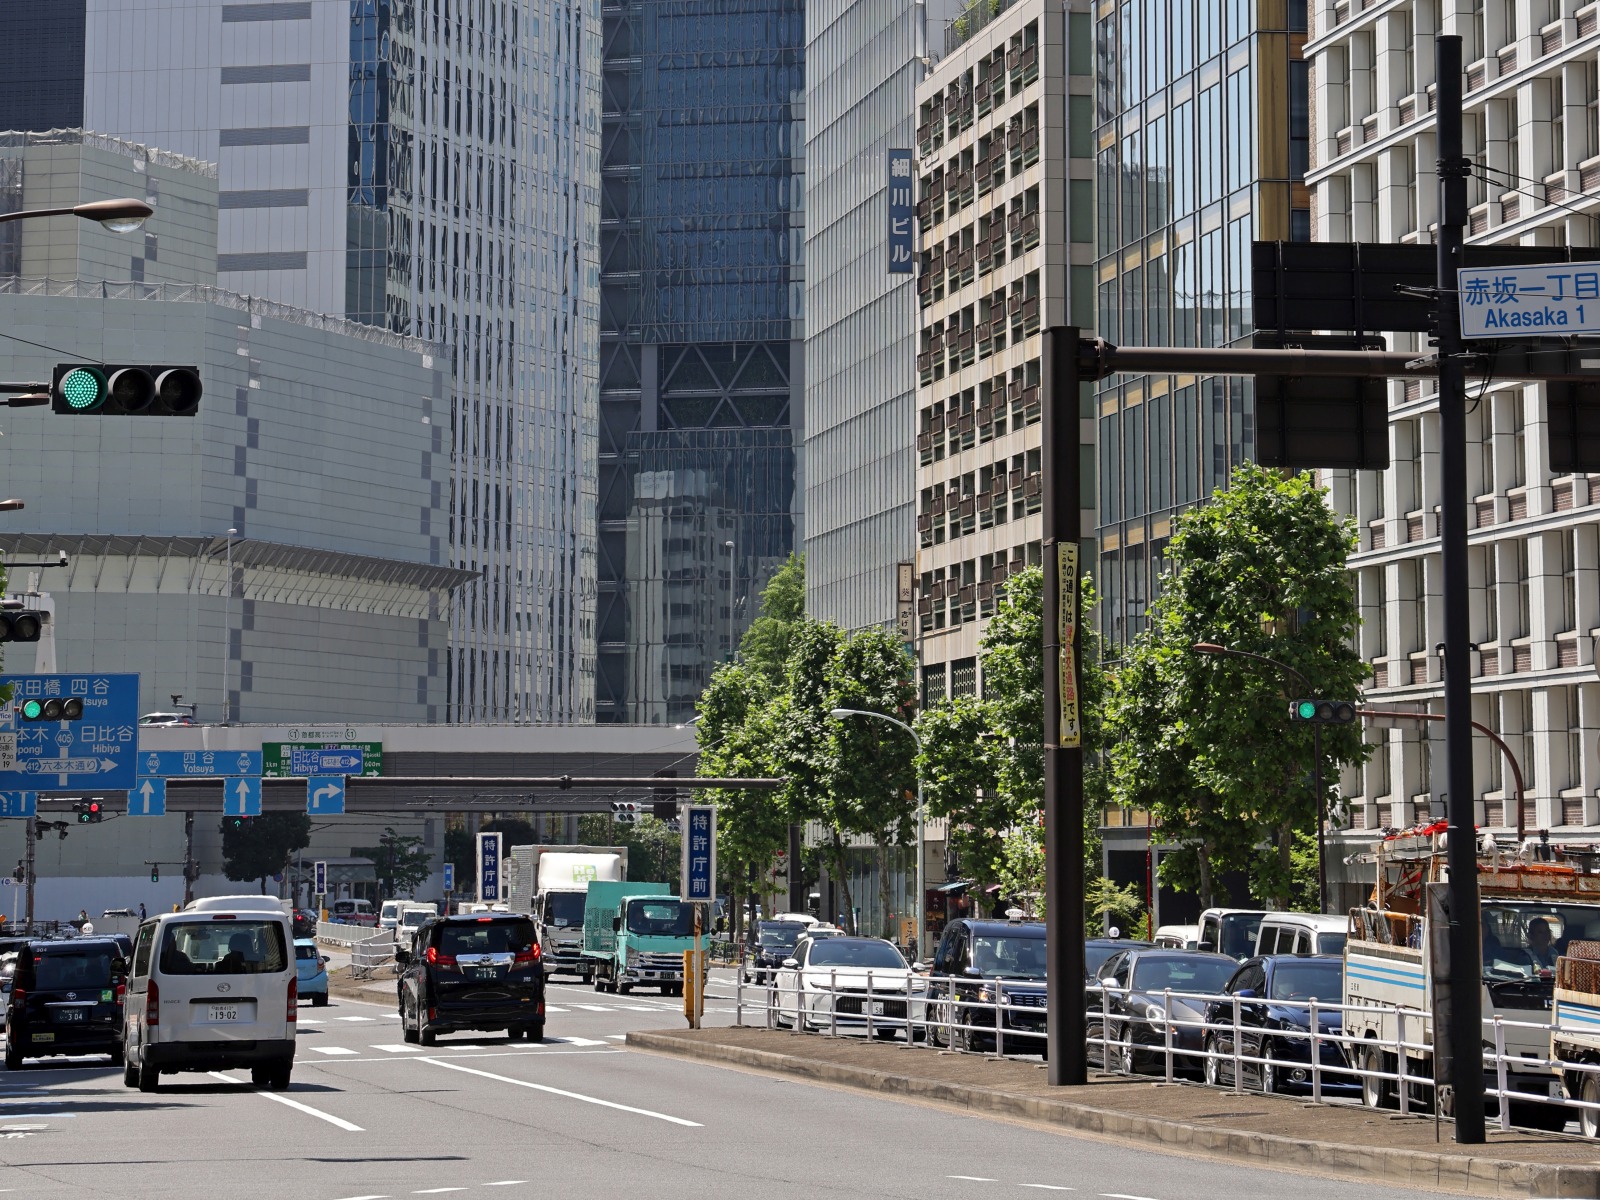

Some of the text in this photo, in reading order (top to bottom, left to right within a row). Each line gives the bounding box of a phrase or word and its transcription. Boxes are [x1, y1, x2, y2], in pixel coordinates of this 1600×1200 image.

[892, 158, 910, 263] 細川ビル
[1465, 272, 1599, 306] 赤坂一丁目
[1485, 304, 1585, 328] Akasaka 1
[71, 679, 110, 695] 四谷
[83, 697, 108, 708] tsuya
[16, 726, 134, 743] 本木 日比谷
[57, 734, 72, 745] 405
[16, 745, 43, 755] pongi
[92, 744, 121, 754] Hibiya
[148, 759, 159, 767] 405
[183, 752, 215, 763] 四谷
[293, 751, 320, 763] 日比谷
[27, 761, 97, 773] 412 六本木通り
[183, 764, 215, 774] Yotsuya
[293, 764, 319, 773] Hibiya
[692, 814, 708, 893] 特許庁前
[484, 839, 496, 896] 特許庁前
[214, 1010, 237, 1020] 19-02
